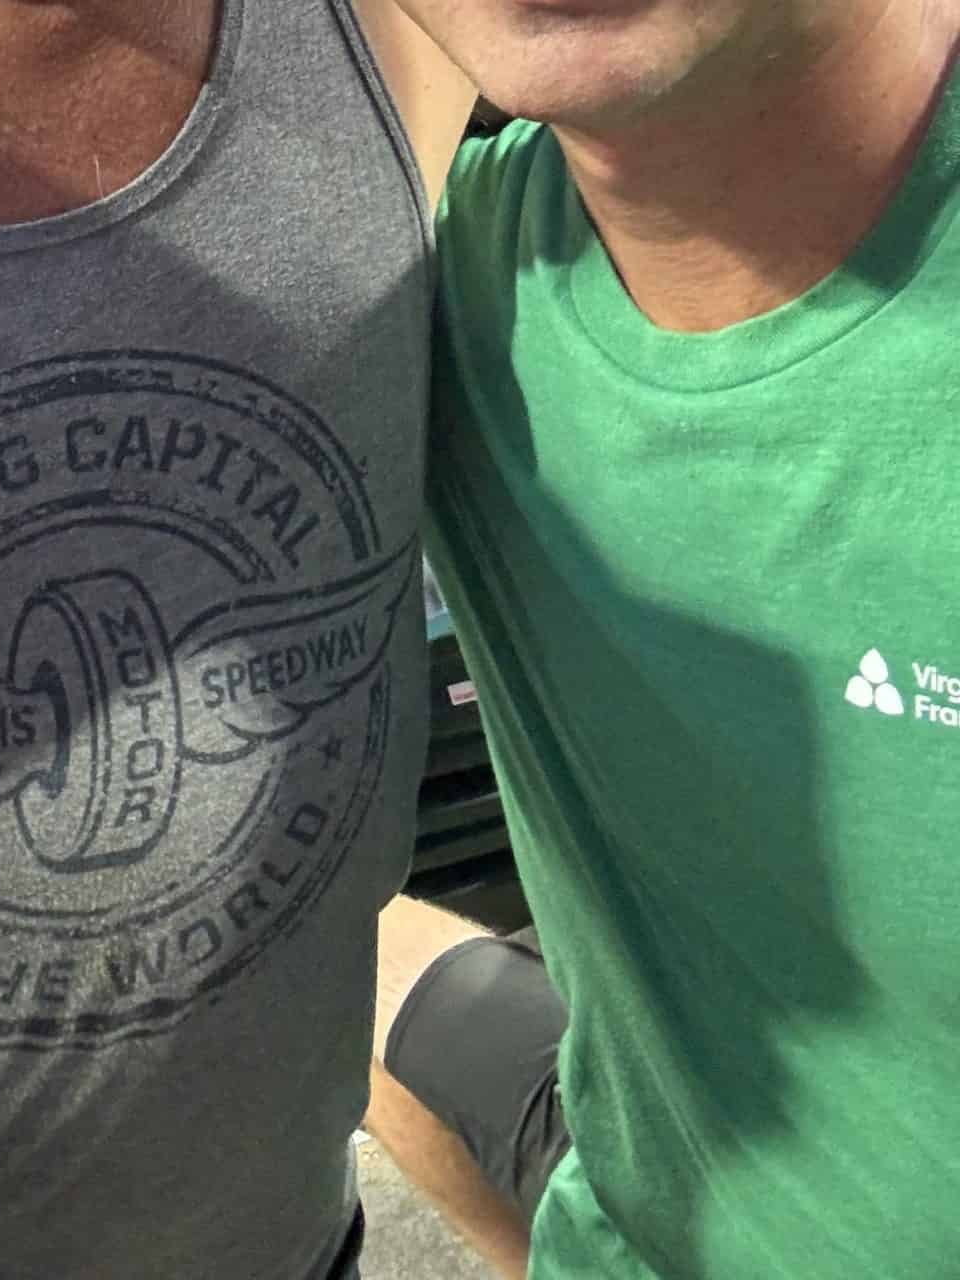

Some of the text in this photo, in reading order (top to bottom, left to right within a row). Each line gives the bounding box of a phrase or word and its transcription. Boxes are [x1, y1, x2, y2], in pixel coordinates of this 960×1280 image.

[64, 416, 322, 570] CAPITAL
[98, 608, 163, 824] MOTOR
[200, 621, 371, 709] SPEEDWAY
[911, 661, 960, 704] Virg
[914, 694, 960, 728] Fra
[108, 800, 332, 988] WORLD
